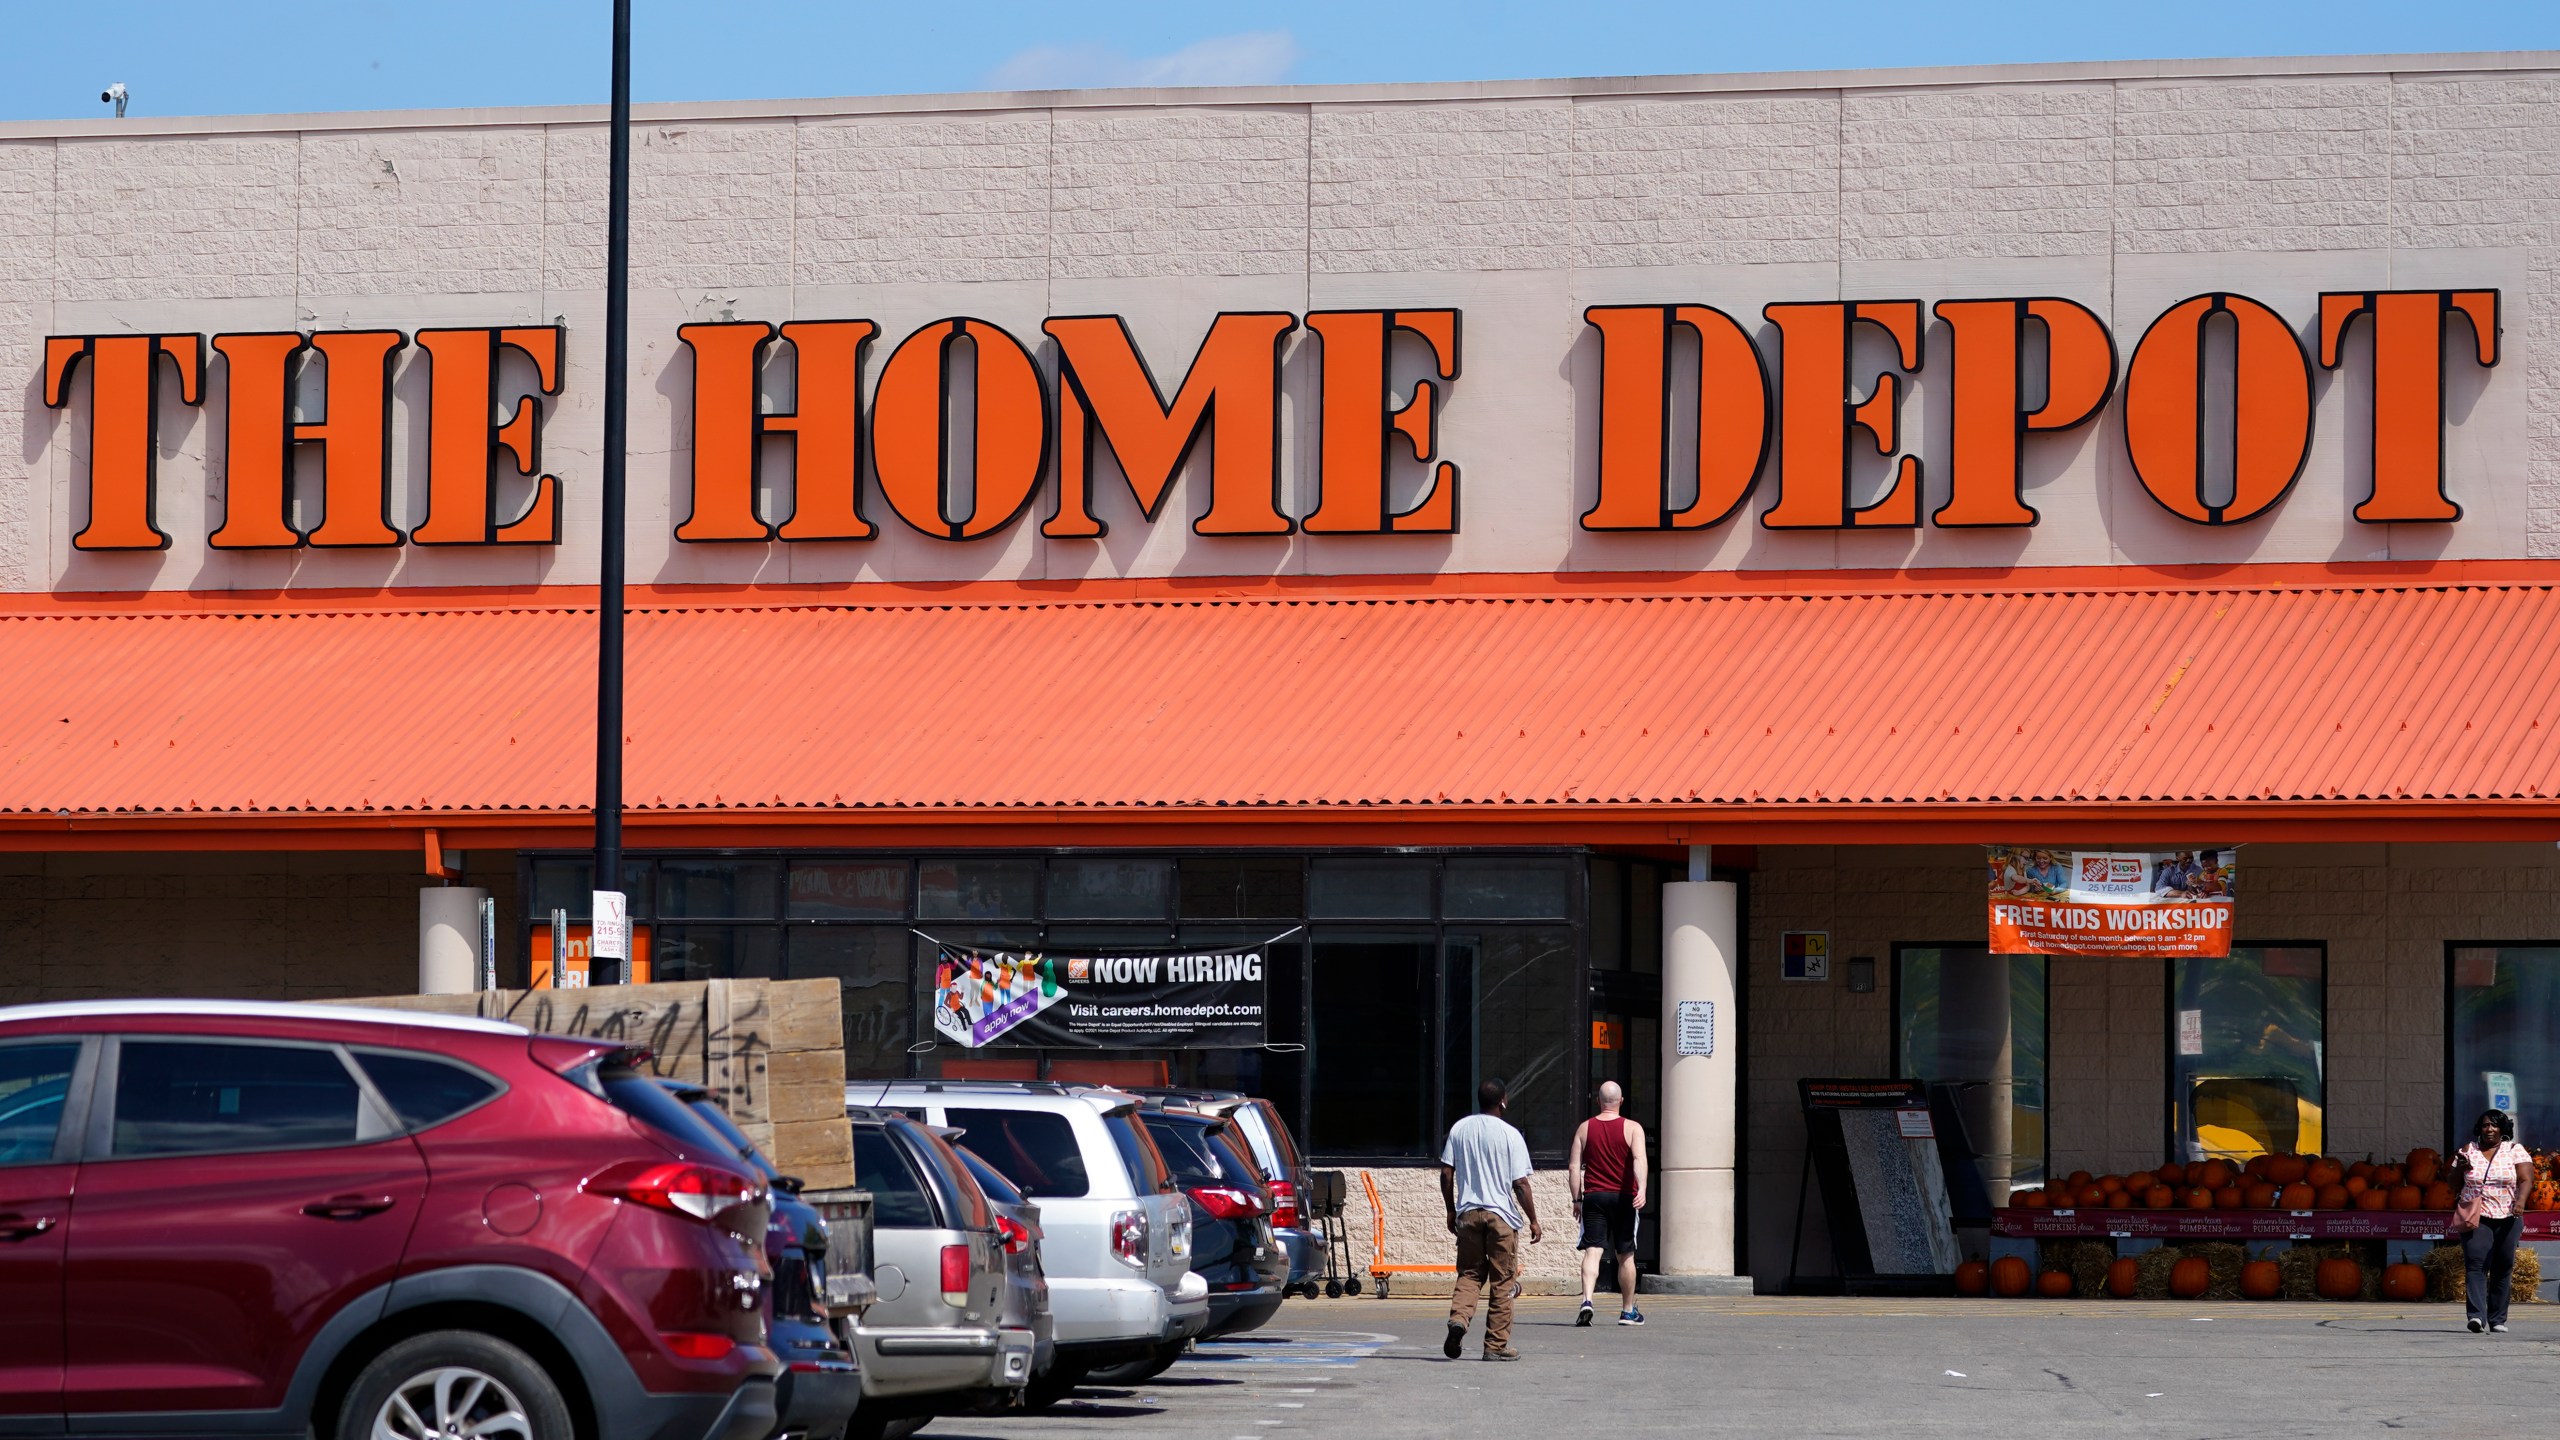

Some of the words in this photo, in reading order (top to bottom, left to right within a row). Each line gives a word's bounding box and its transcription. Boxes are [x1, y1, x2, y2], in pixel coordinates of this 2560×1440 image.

[44, 324, 566, 551] THE
[674, 307, 1462, 543] HOME
[1580, 288, 2501, 531] DEPOT
[2112, 864, 2136, 872] KIDS
[1994, 904, 2045, 928] FREE
[2051, 908, 2101, 930] KIDS
[2107, 908, 2229, 930] WORKSHOP
[2037, 931, 2069, 942] Saturday
[2080, 934, 2095, 942] each
[2194, 935, 2205, 943] pm
[1809, 938, 1823, 952] 2
[2028, 940, 2044, 949] Visit
[2045, 941, 2147, 952] homedepot.com/workshops
[1095, 958, 1160, 983] NOW
[1167, 953, 1261, 982] HIRING
[983, 1012, 1009, 1034] apply
[1009, 1000, 1030, 1017] now
[1069, 1004, 1099, 1017] Visit
[1101, 1004, 1262, 1019] careers.homedepot.com
[2034, 1224, 2077, 1232] PUMPKINS
[2106, 1224, 2150, 1232] PUMPKINS
[2179, 1224, 2223, 1233] PUMPKINS
[2252, 1225, 2296, 1233] PUMPKINS
[2326, 1225, 2370, 1233] PUMPKINS
[2400, 1225, 2444, 1233] PUMPKINS
